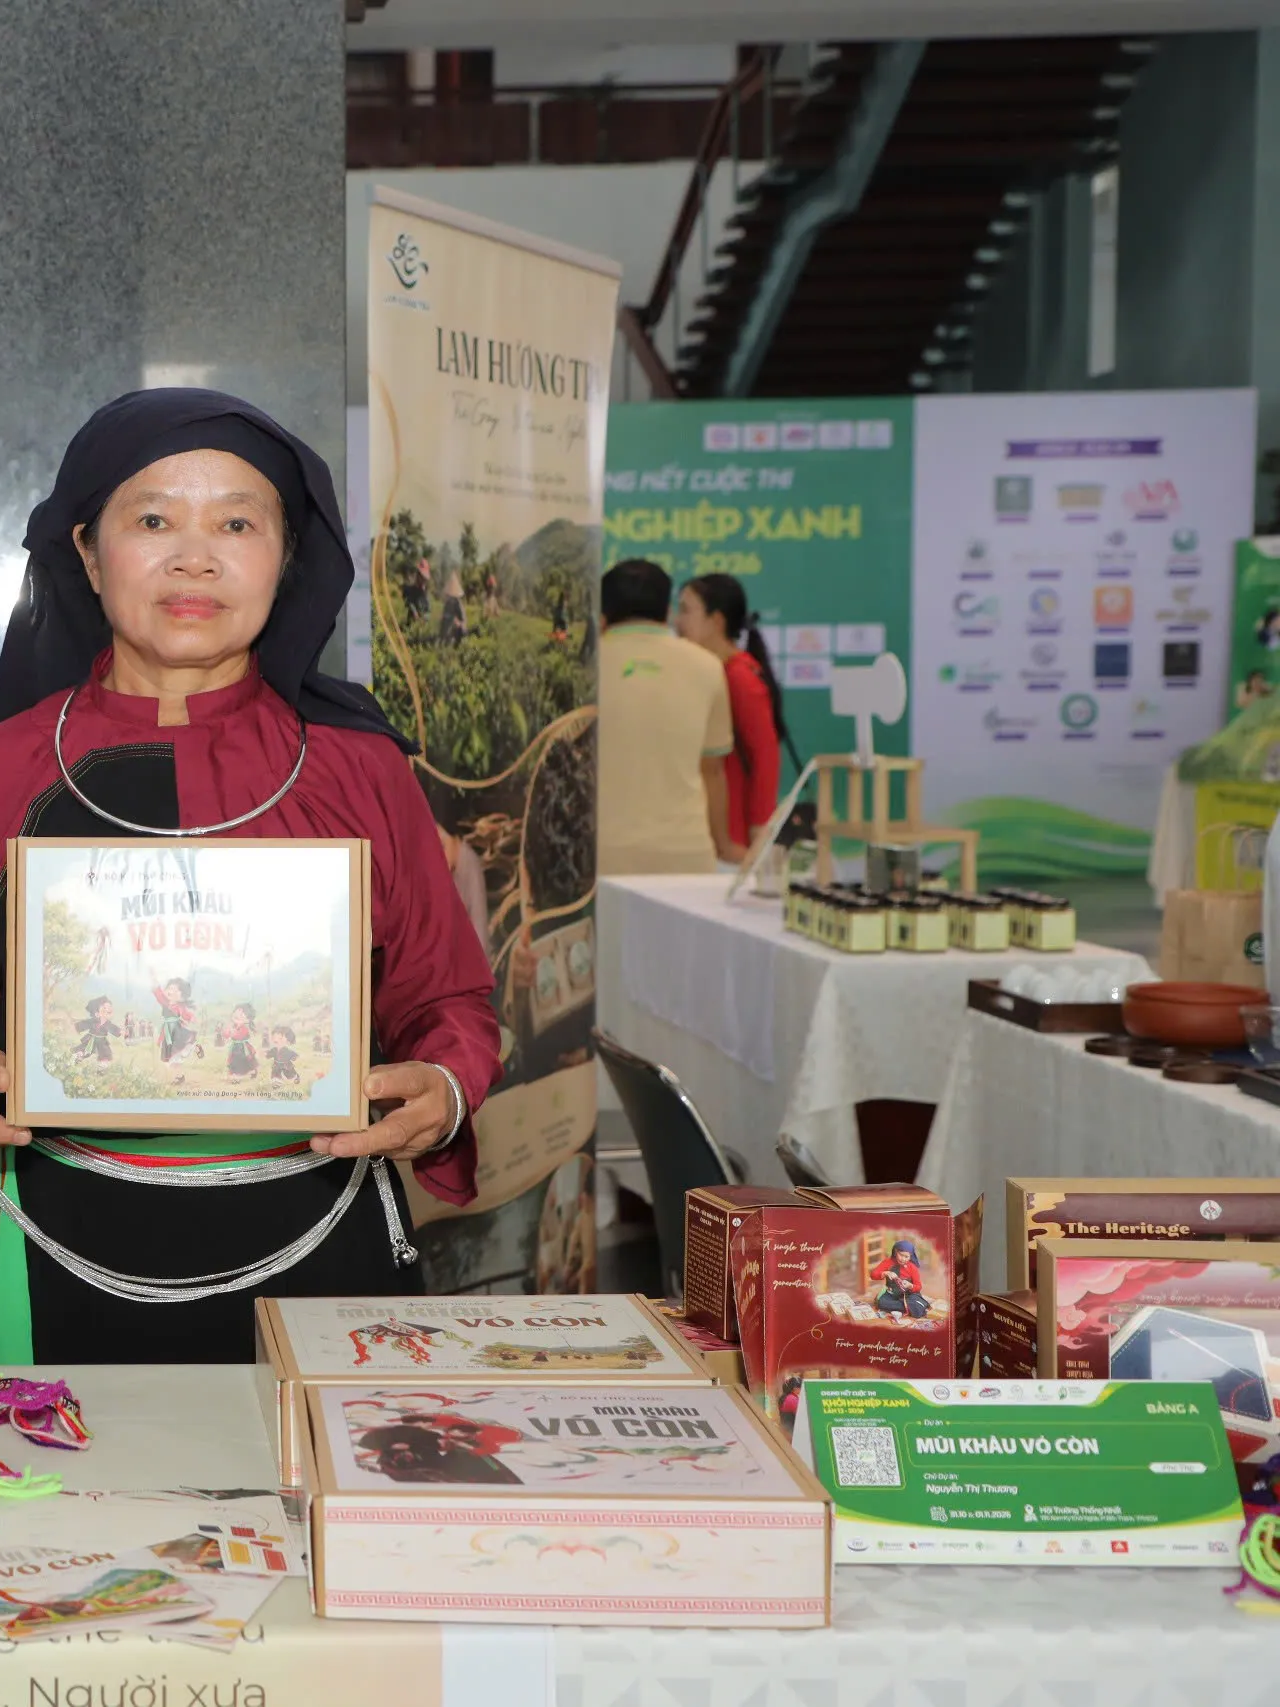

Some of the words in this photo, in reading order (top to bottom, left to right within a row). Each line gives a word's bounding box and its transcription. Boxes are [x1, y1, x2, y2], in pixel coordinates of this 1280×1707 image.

[436, 325, 479, 380] LAM
[746, 503, 863, 540] XANH
[1066, 1222, 1101, 1234] The
[1105, 1221, 1191, 1238] Heritage
[773, 1242, 798, 1255] single
[777, 1261, 808, 1271] connects
[455, 1315, 516, 1328] VÓ
[523, 1314, 609, 1328] CÒN
[835, 1338, 854, 1350] From
[857, 1341, 904, 1353] grandmother
[889, 1354, 909, 1367] story
[882, 1398, 910, 1408] XANH
[1145, 1400, 1187, 1414] BẢNG
[1188, 1403, 1200, 1414] A
[638, 1405, 701, 1417] KHÂU
[527, 1414, 602, 1437] VÓ
[609, 1415, 719, 1439] CÒN
[915, 1435, 957, 1454] MŨI
[958, 1434, 1018, 1455] KHÂU
[1019, 1435, 1052, 1455] VÓ
[1054, 1435, 1100, 1455] CÒN
[926, 1482, 963, 1495] Nguyễn
[965, 1483, 980, 1494] Thị
[982, 1483, 1019, 1495] Thương
[47, 1551, 116, 1570] CÒN
[29, 1674, 168, 1707] Người
[186, 1677, 266, 1707] xưa
